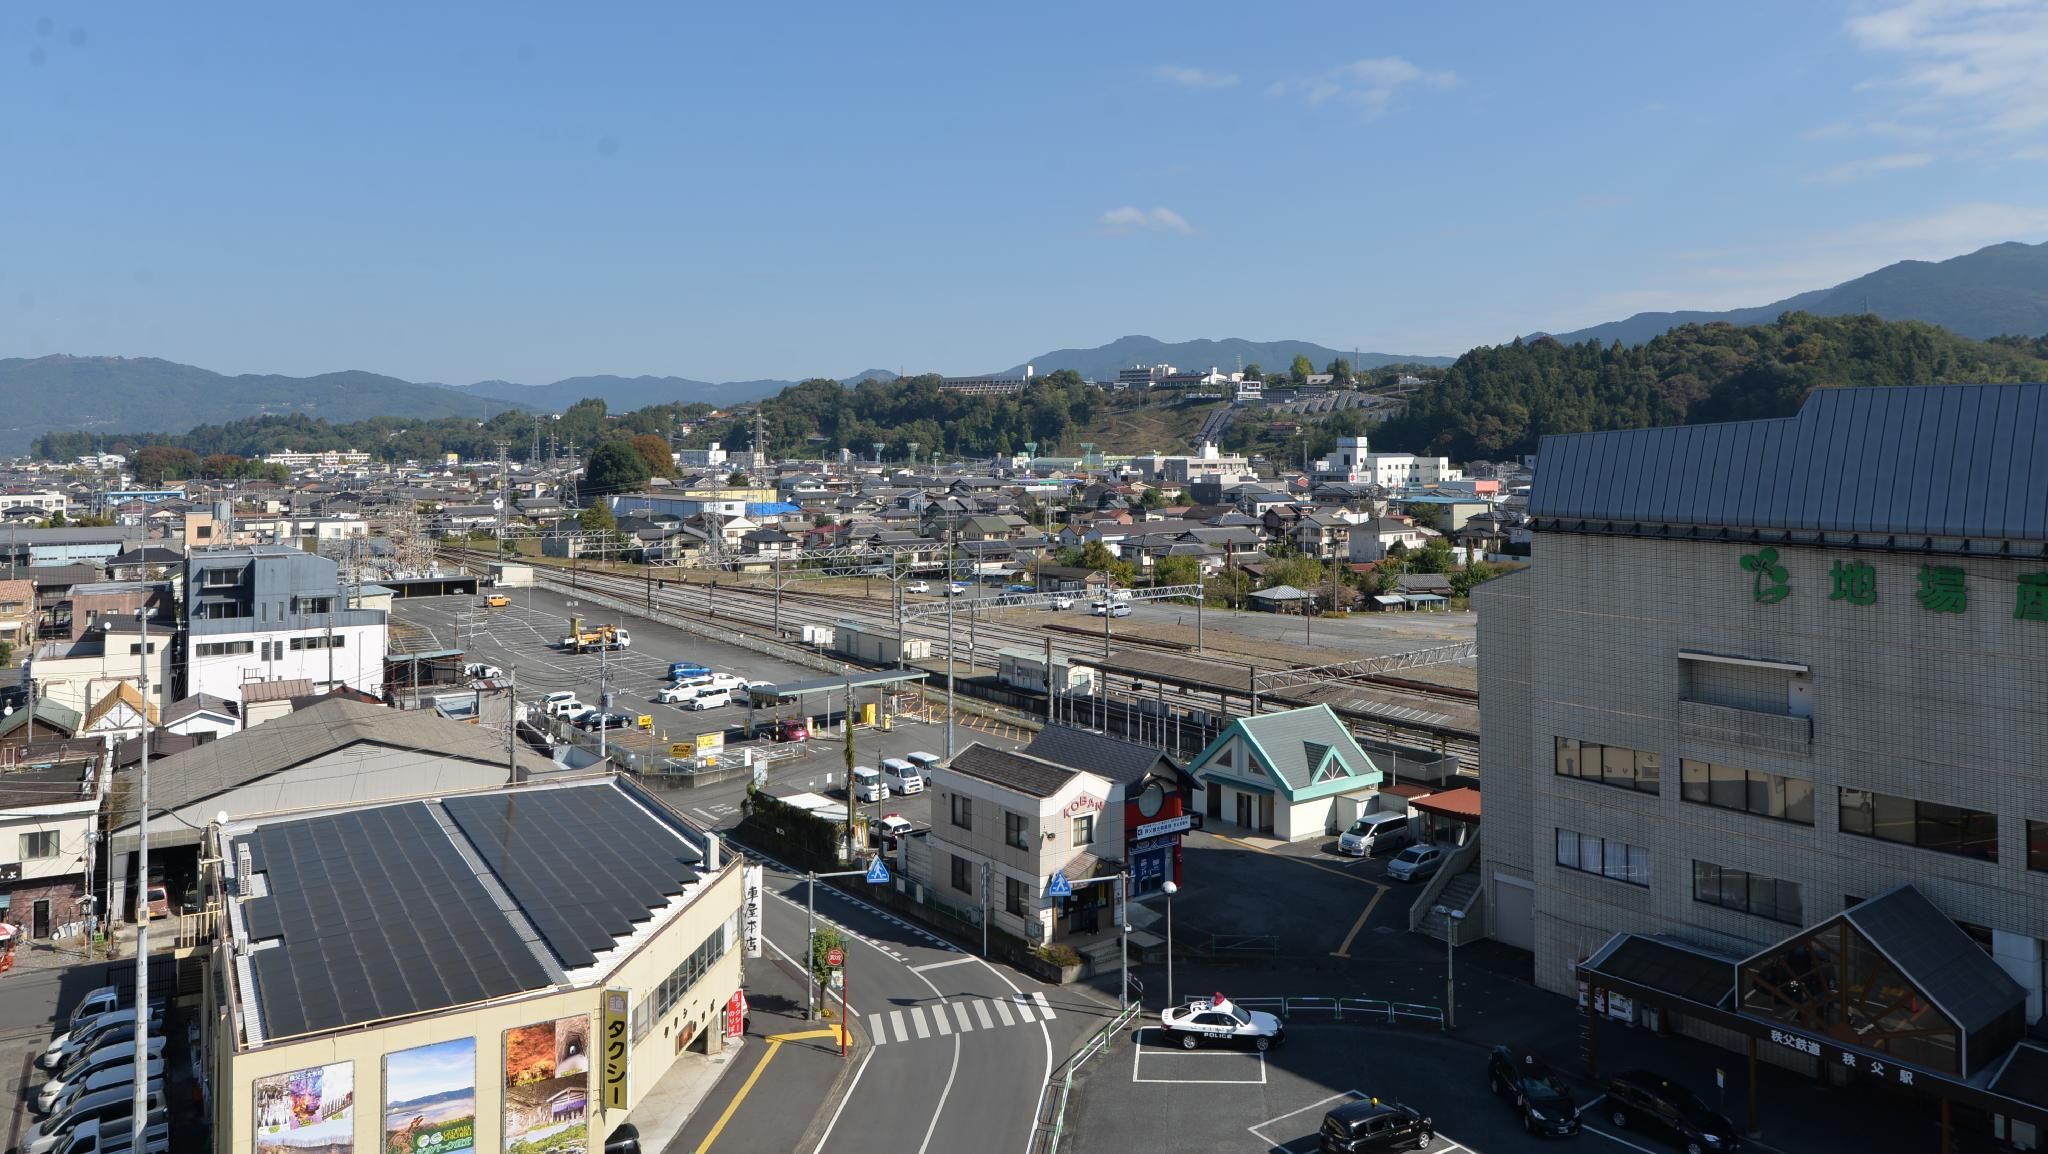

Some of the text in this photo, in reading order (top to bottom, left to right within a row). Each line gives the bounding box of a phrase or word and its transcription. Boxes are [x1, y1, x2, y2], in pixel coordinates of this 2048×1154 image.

[1063, 795, 1105, 819] KOBAN
[744, 886, 759, 952] 車屋本店
[608, 1020, 625, 1105] タクシー
[1203, 1031, 1233, 1040] POLICE
[1770, 1029, 1914, 1086] 秩父鉄道 秩父駅
